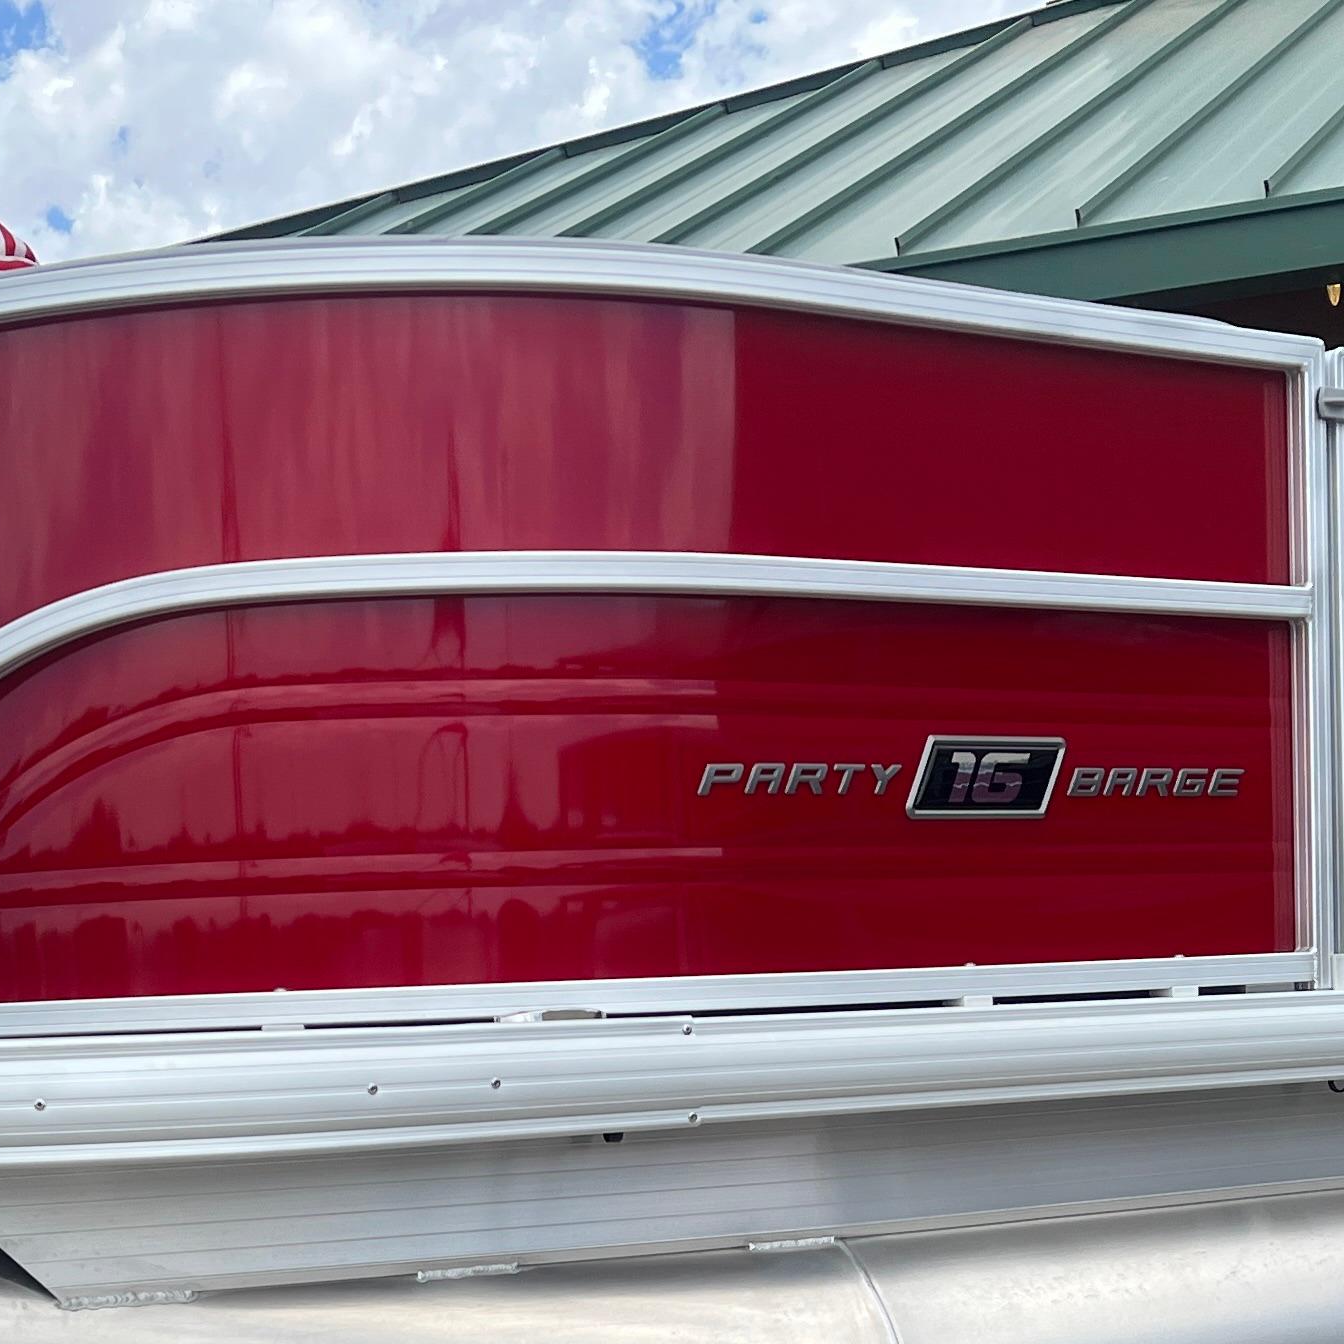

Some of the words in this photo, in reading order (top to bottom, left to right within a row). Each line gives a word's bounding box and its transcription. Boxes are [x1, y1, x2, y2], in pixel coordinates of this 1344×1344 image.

[697, 762, 902, 796] PARTY
[947, 751, 1032, 805] 16
[1066, 767, 1246, 797] BARGE
